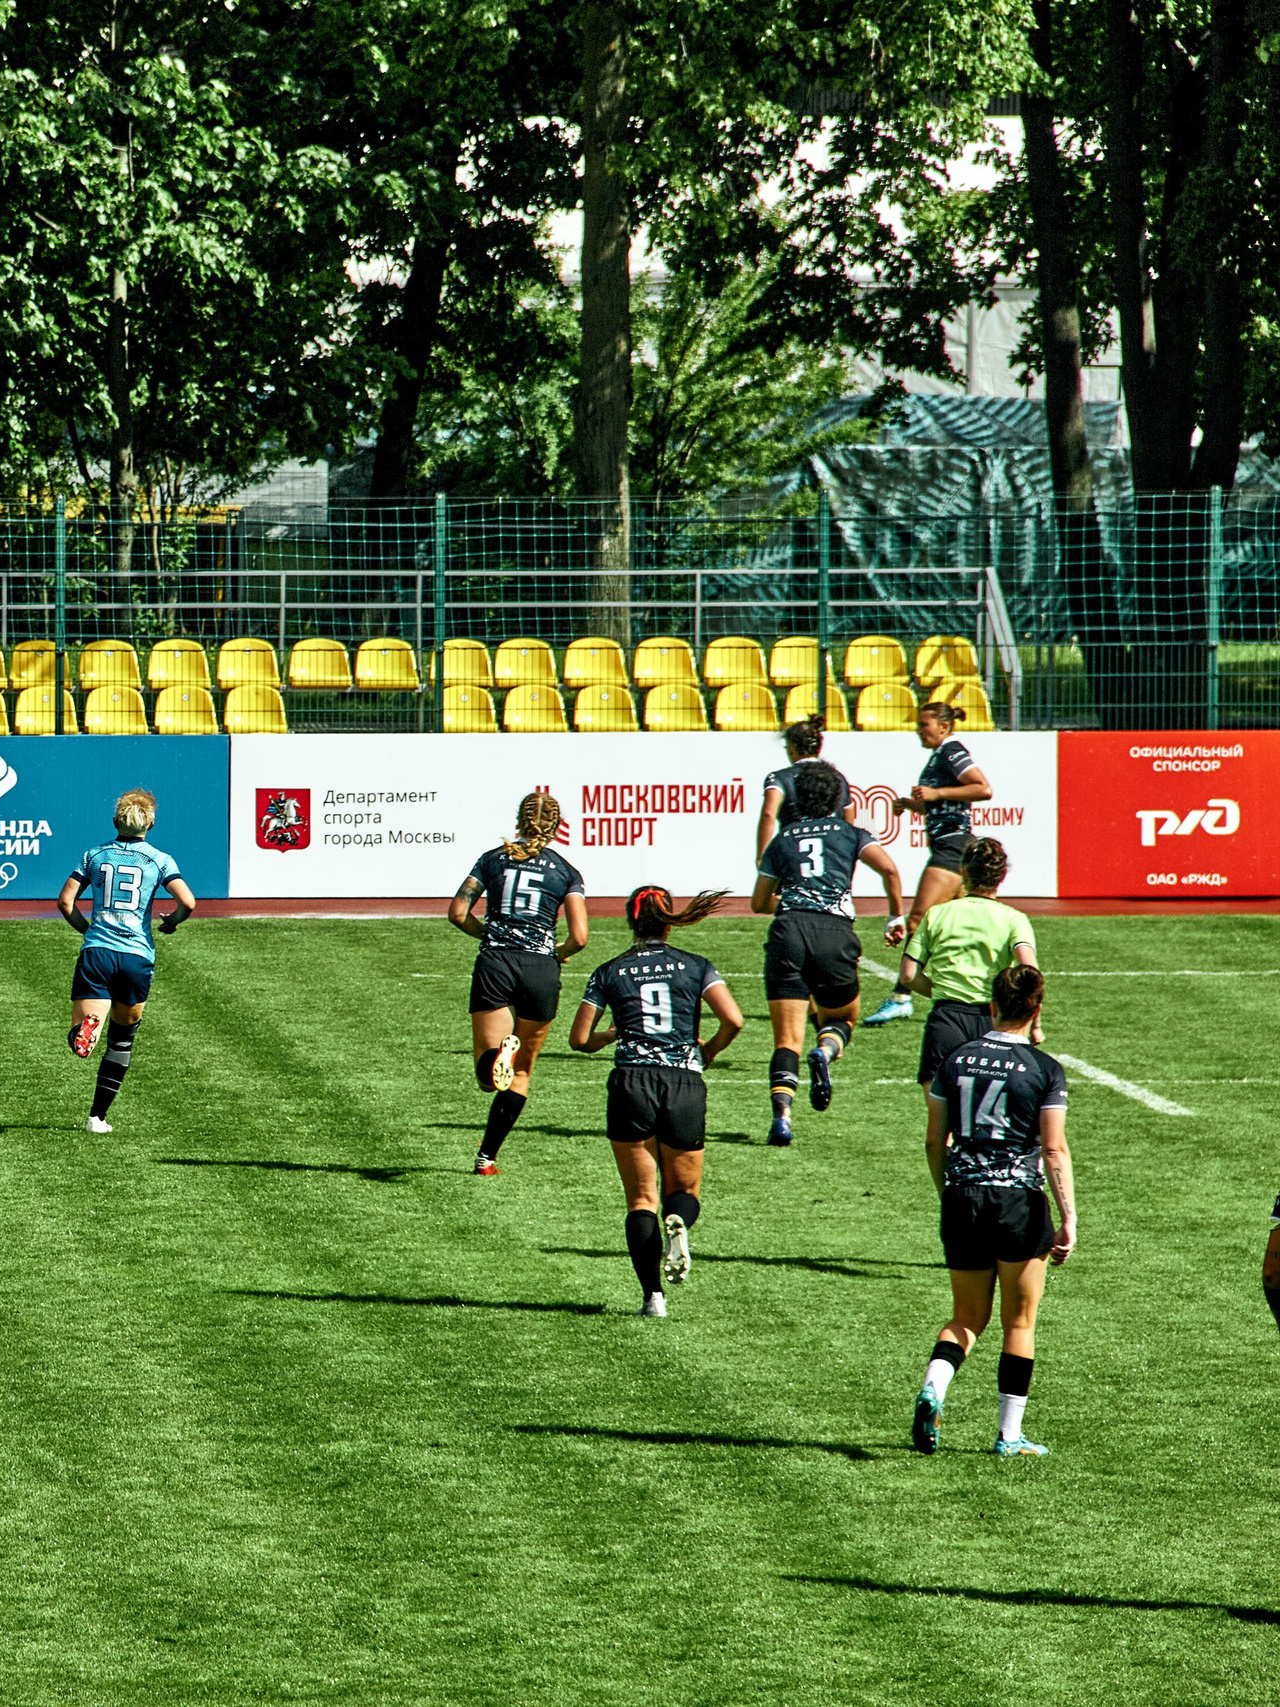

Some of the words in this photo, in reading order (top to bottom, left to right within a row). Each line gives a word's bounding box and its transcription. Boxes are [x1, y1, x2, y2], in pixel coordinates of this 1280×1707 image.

[1130, 744, 1243, 758] ОФИЦИАЛЬНЫЙ
[1153, 760, 1221, 772] СПОНСОР
[323, 790, 437, 807] Департамент
[582, 778, 744, 814] МОСКОВСКИЙ
[323, 812, 382, 828] спорта
[910, 808, 1025, 826] МСКОМУ
[324, 832, 382, 848] города
[388, 830, 455, 844] Москвы
[582, 817, 657, 846] СПОРТ
[799, 838, 825, 877] 3
[100, 863, 143, 911] 13
[1147, 873, 1177, 885] ОАО
[1181, 873, 1228, 886] «РЖД»
[501, 868, 545, 916] 15
[640, 982, 673, 1034] 9
[957, 1076, 1010, 1139] 14
